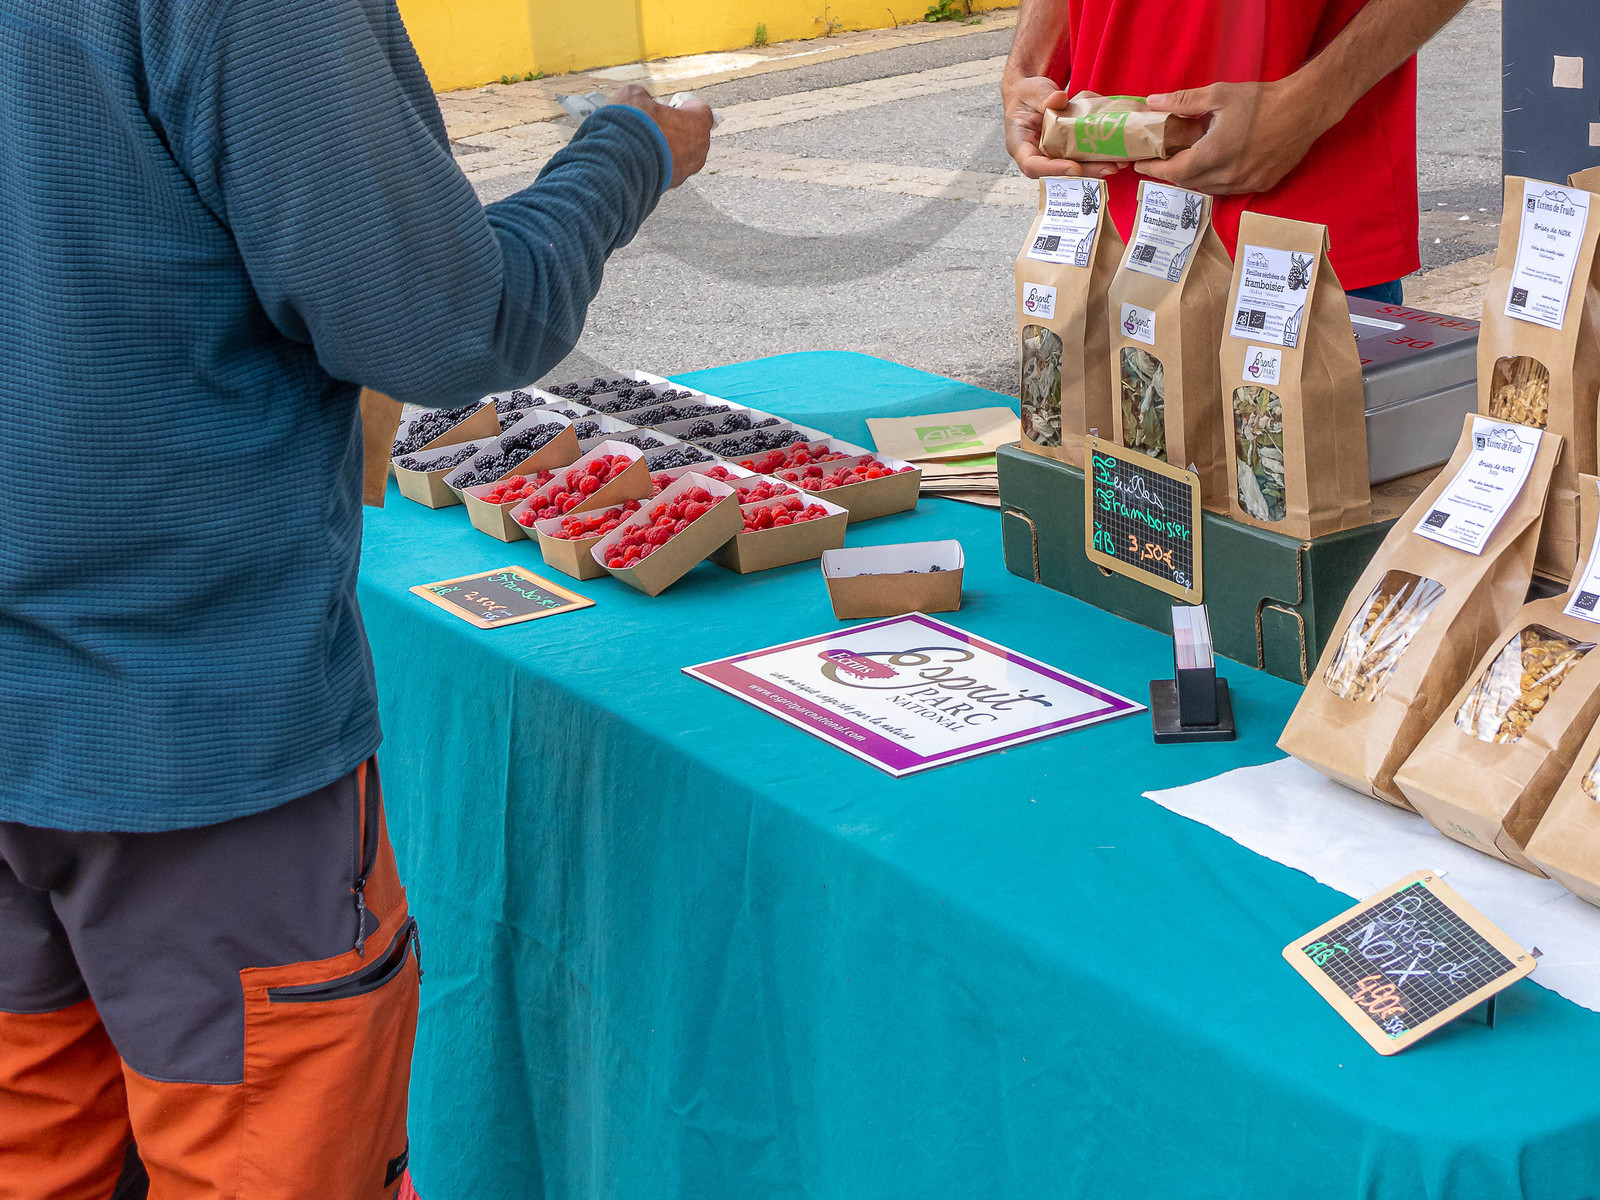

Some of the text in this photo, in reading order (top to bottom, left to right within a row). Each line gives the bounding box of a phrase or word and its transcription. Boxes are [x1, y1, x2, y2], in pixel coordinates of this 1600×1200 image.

[1047, 208, 1079, 219] framboisier
[1537, 199, 1576, 217] Ecrins de Fruits
[1143, 214, 1178, 231] framboisier
[1246, 268, 1286, 281] Feuilles séchées de
[1245, 277, 1285, 293] framboisier
[1376, 306, 1480, 332] FRUITS
[1386, 336, 1435, 349] DE
[1486, 437, 1522, 454] Ecrins de Fruits
[829, 651, 876, 675] Ecrins
[821, 646, 1053, 711] Esprit
[748, 683, 867, 742] www.espritparcnational.com
[884, 695, 966, 733] NATIONAL
[907, 687, 998, 726] PARC
